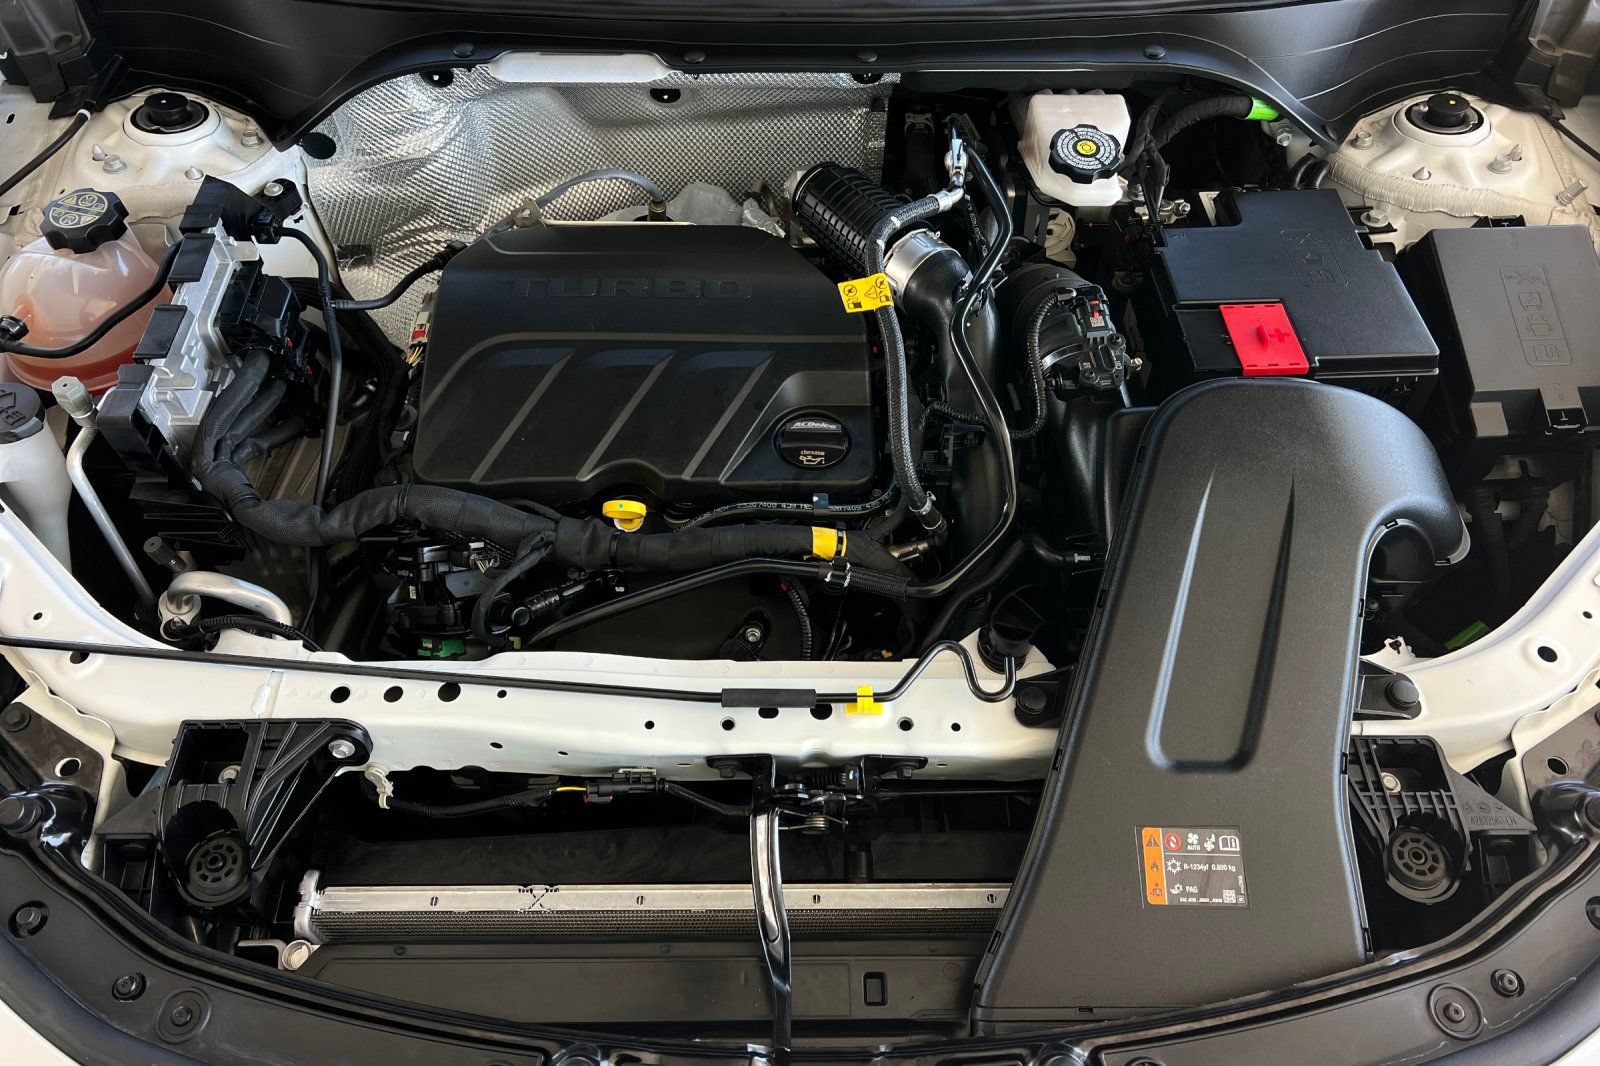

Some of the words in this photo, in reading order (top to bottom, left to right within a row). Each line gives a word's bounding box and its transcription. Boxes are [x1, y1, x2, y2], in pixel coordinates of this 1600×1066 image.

[497, 277, 753, 299] TURBO
[792, 421, 837, 429] ACDelco
[1183, 864, 1209, 872] R-1234yf
[1185, 885, 1198, 893] PAG
